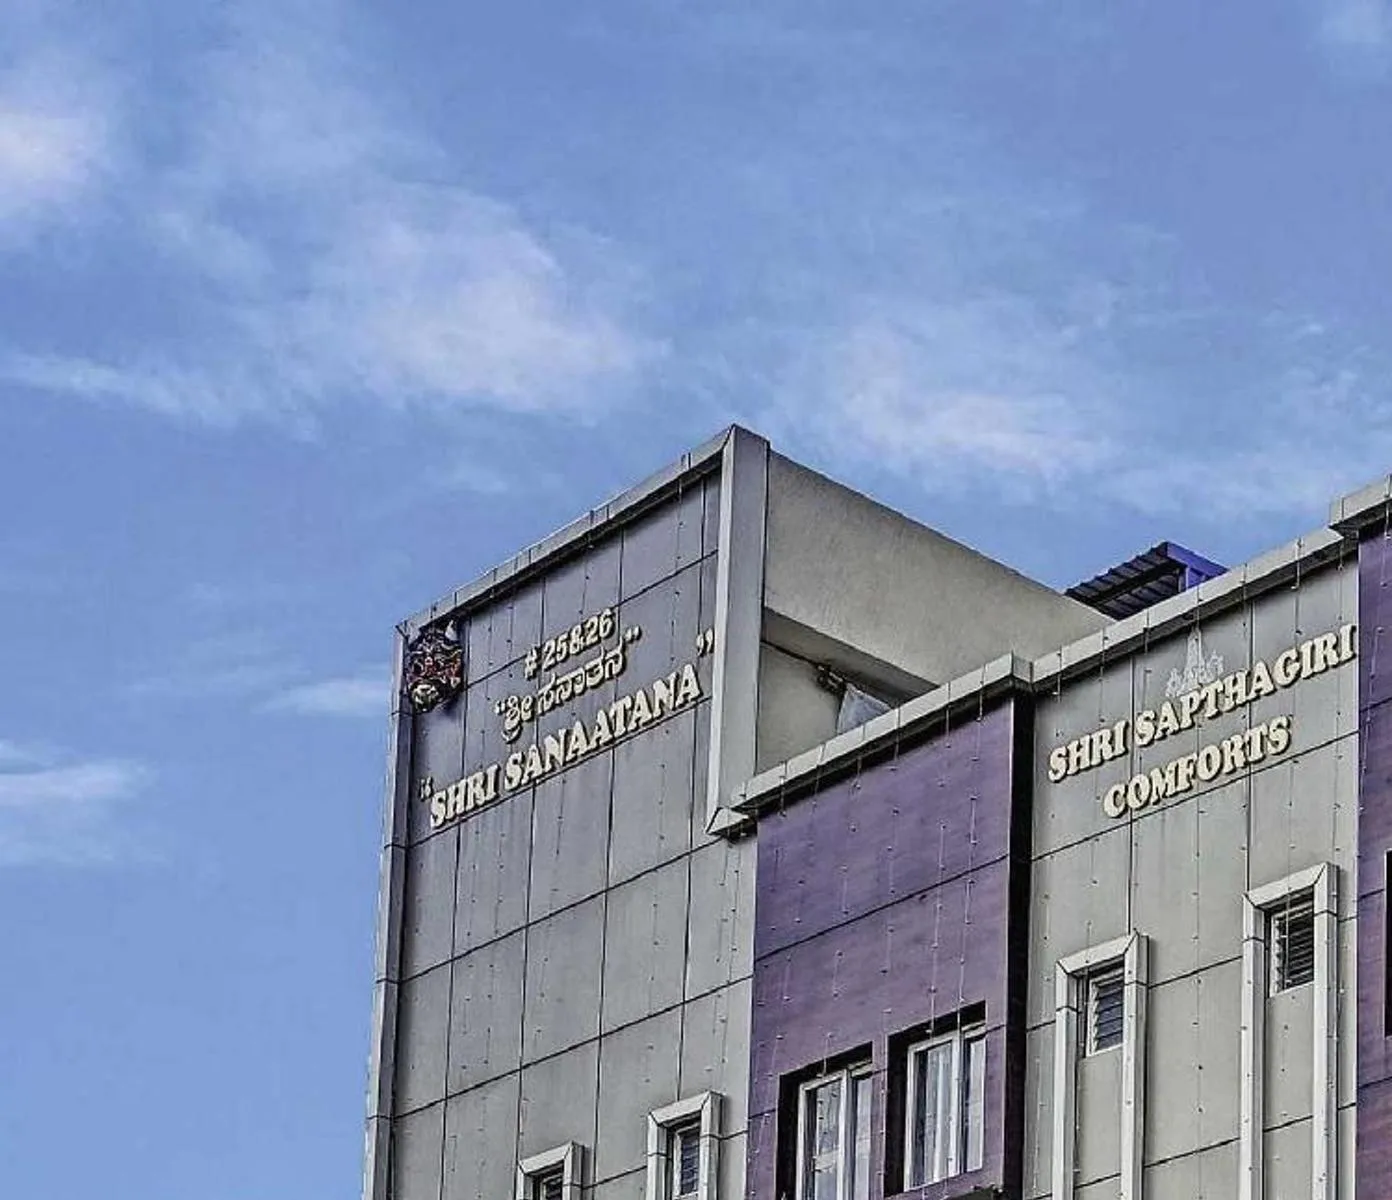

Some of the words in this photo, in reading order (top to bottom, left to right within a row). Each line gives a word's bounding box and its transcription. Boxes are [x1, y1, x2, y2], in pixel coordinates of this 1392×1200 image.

[1048, 719, 1129, 784] SHRI
[1133, 623, 1358, 747] SAPTHAGIRI
[1103, 715, 1292, 819] COMFORTS
